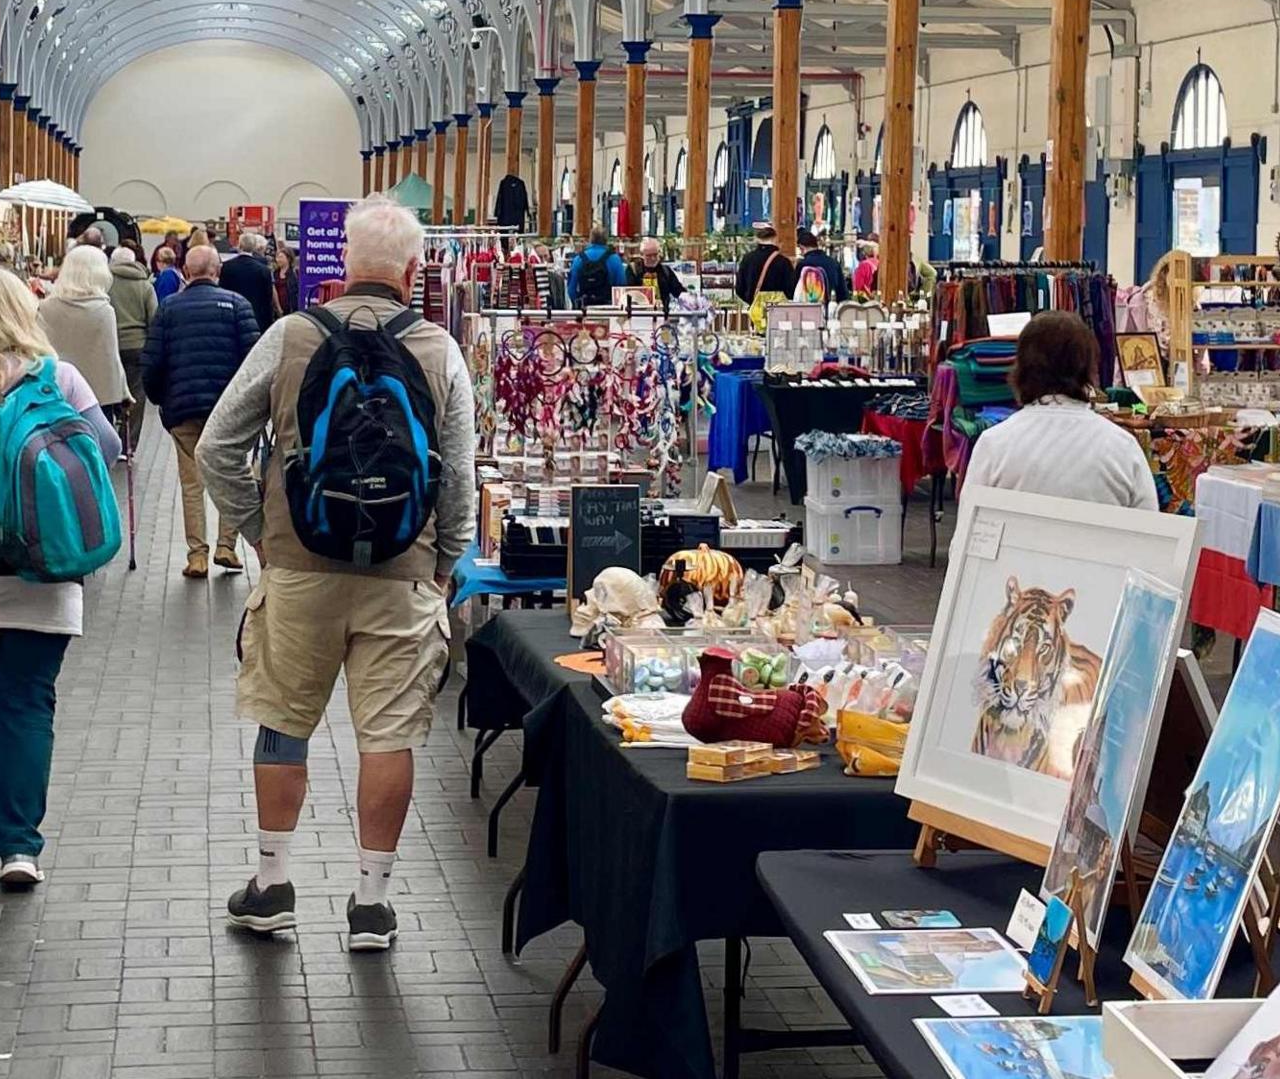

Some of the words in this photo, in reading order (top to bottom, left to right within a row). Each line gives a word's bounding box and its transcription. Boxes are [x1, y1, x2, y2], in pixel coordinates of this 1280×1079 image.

[307, 227, 325, 236] Get
[327, 227, 339, 236] all
[306, 240, 334, 249] home
[306, 252, 316, 261] in
[317, 253, 338, 262] one,
[306, 266, 345, 276] monthly
[583, 514, 615, 526] WAY
